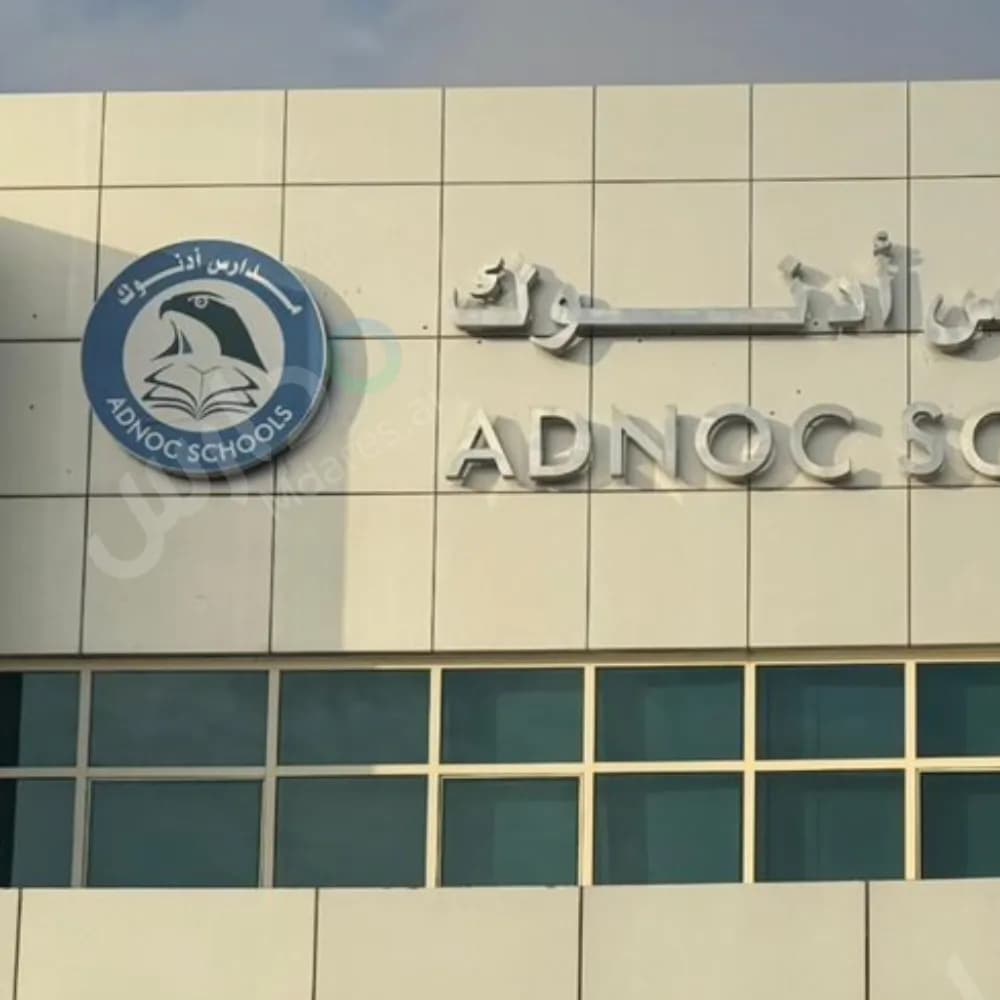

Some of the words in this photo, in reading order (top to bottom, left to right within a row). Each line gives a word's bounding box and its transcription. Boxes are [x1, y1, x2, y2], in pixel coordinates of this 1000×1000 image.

[105, 395, 182, 461] ADNOC
[187, 404, 293, 463] SCHOOLS
[446, 404, 855, 482] ADNOC
